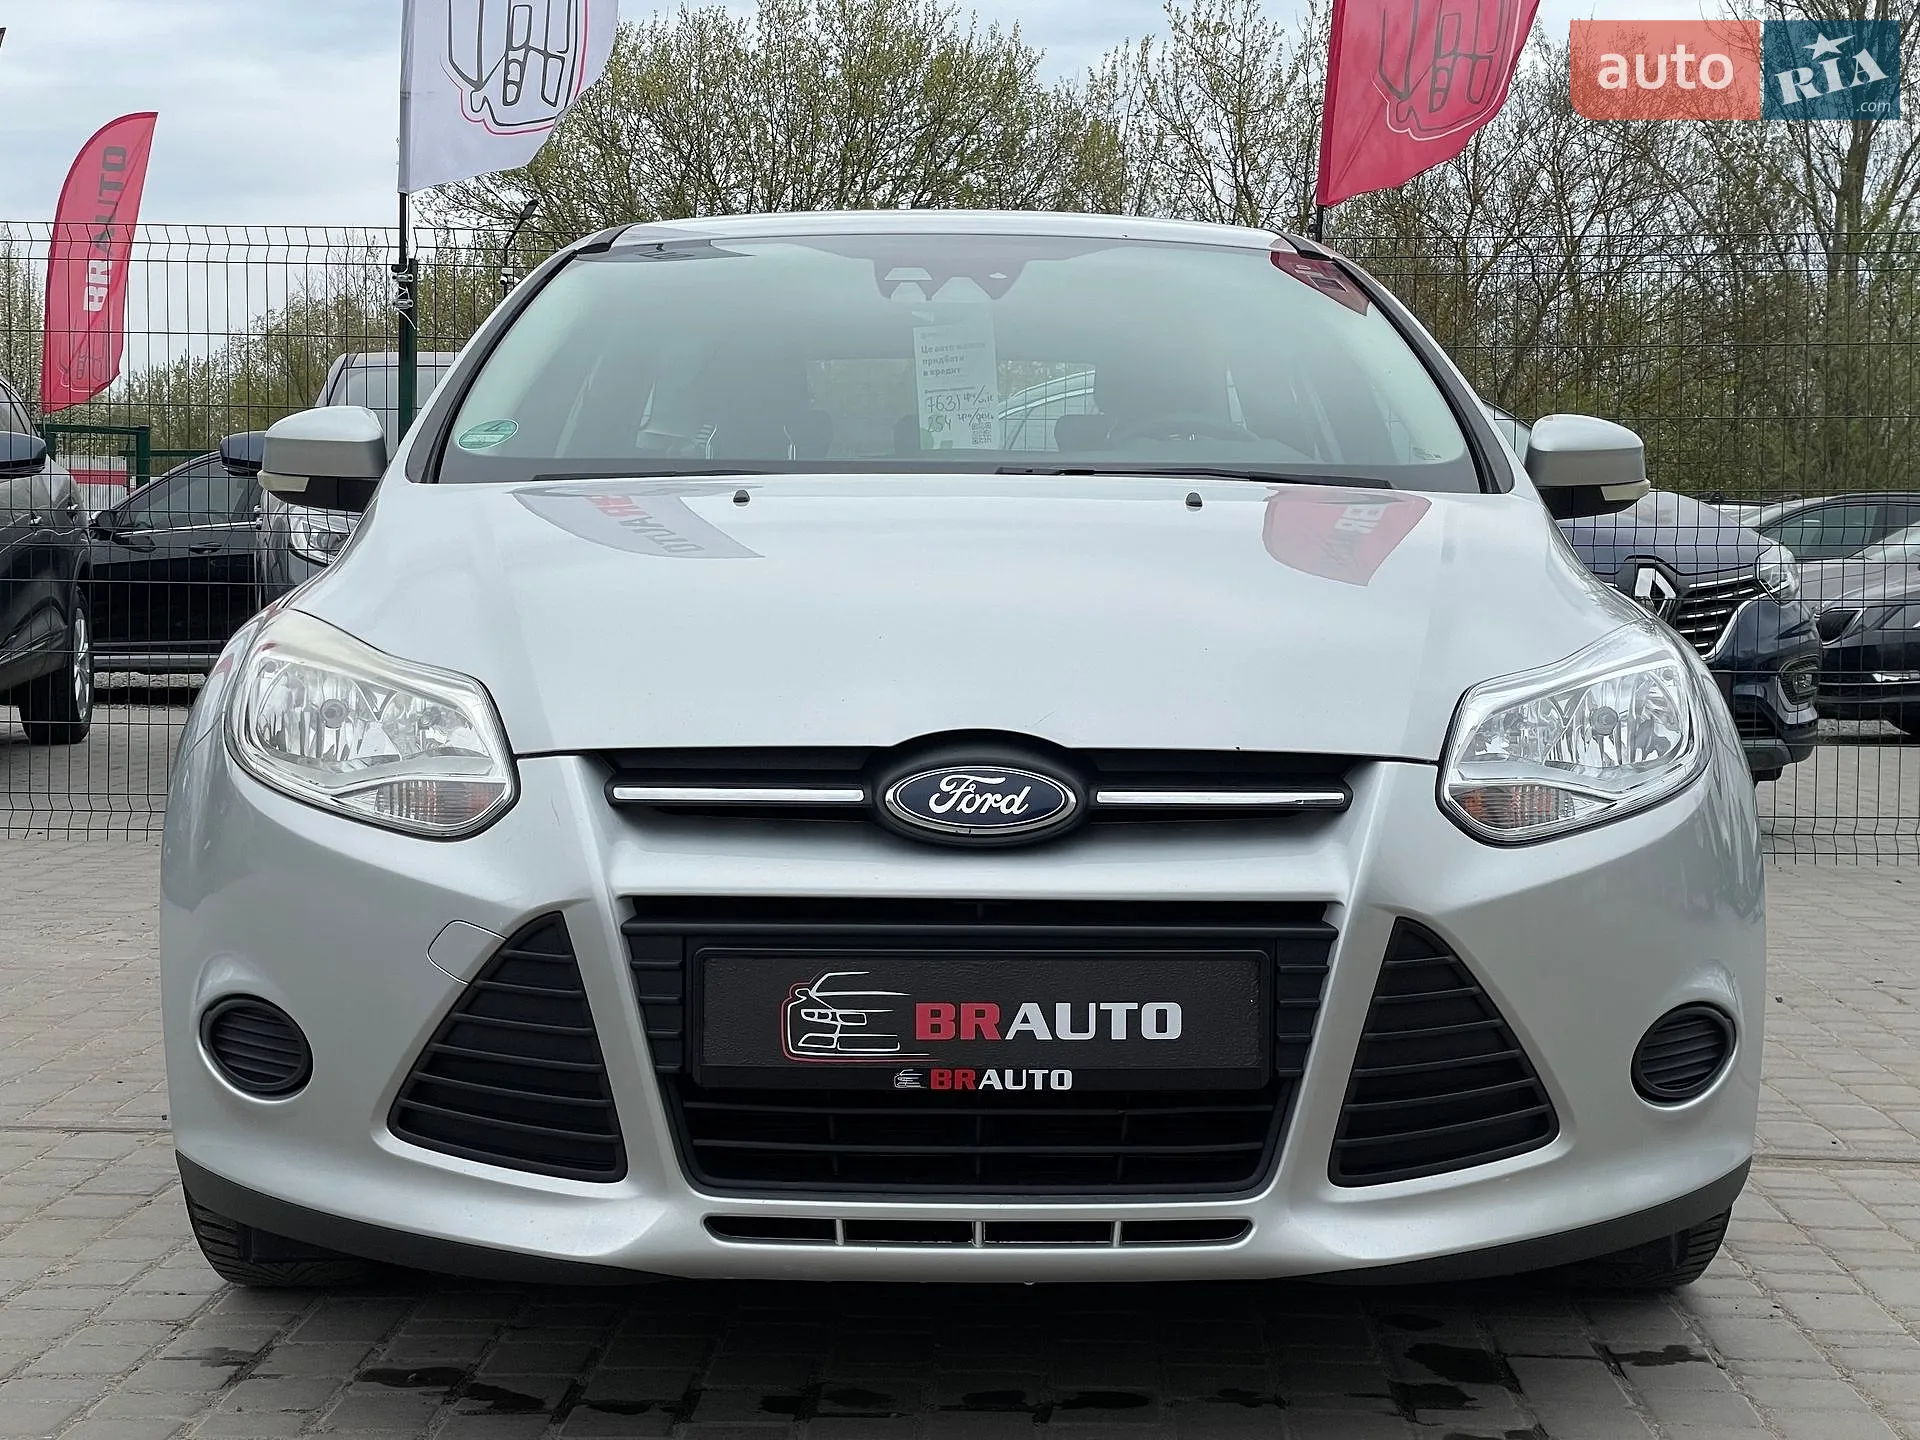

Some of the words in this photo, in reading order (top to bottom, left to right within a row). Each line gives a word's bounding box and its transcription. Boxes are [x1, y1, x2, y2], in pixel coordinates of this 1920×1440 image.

[928, 774, 1032, 815] Ford
[915, 1001, 1182, 1041] BRAUTO
[930, 1069, 1072, 1091] BRAUTO
